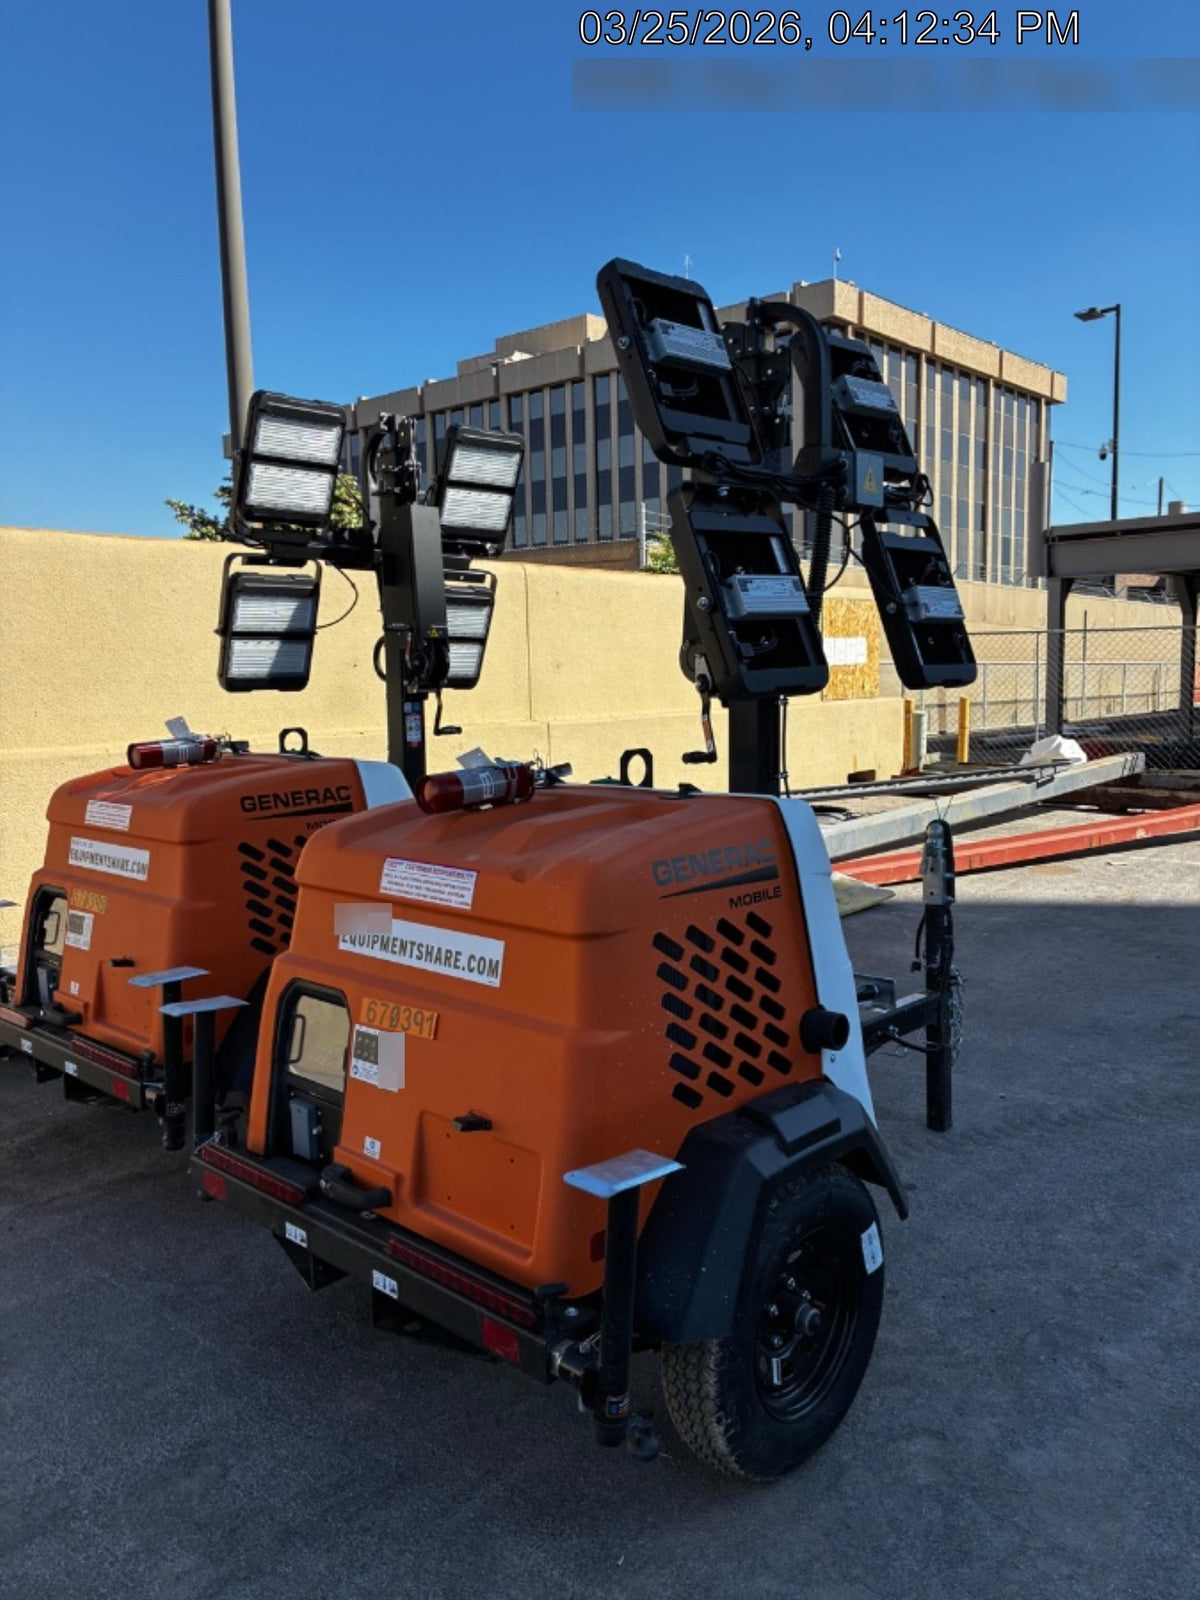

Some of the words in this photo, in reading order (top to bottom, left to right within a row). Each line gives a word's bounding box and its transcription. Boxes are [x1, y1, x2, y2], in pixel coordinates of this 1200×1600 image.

[241, 785, 351, 812] GENERAC
[652, 840, 776, 886] GENERAC
[729, 886, 782, 909] MOBILE
[365, 1000, 435, 1038] 670391
